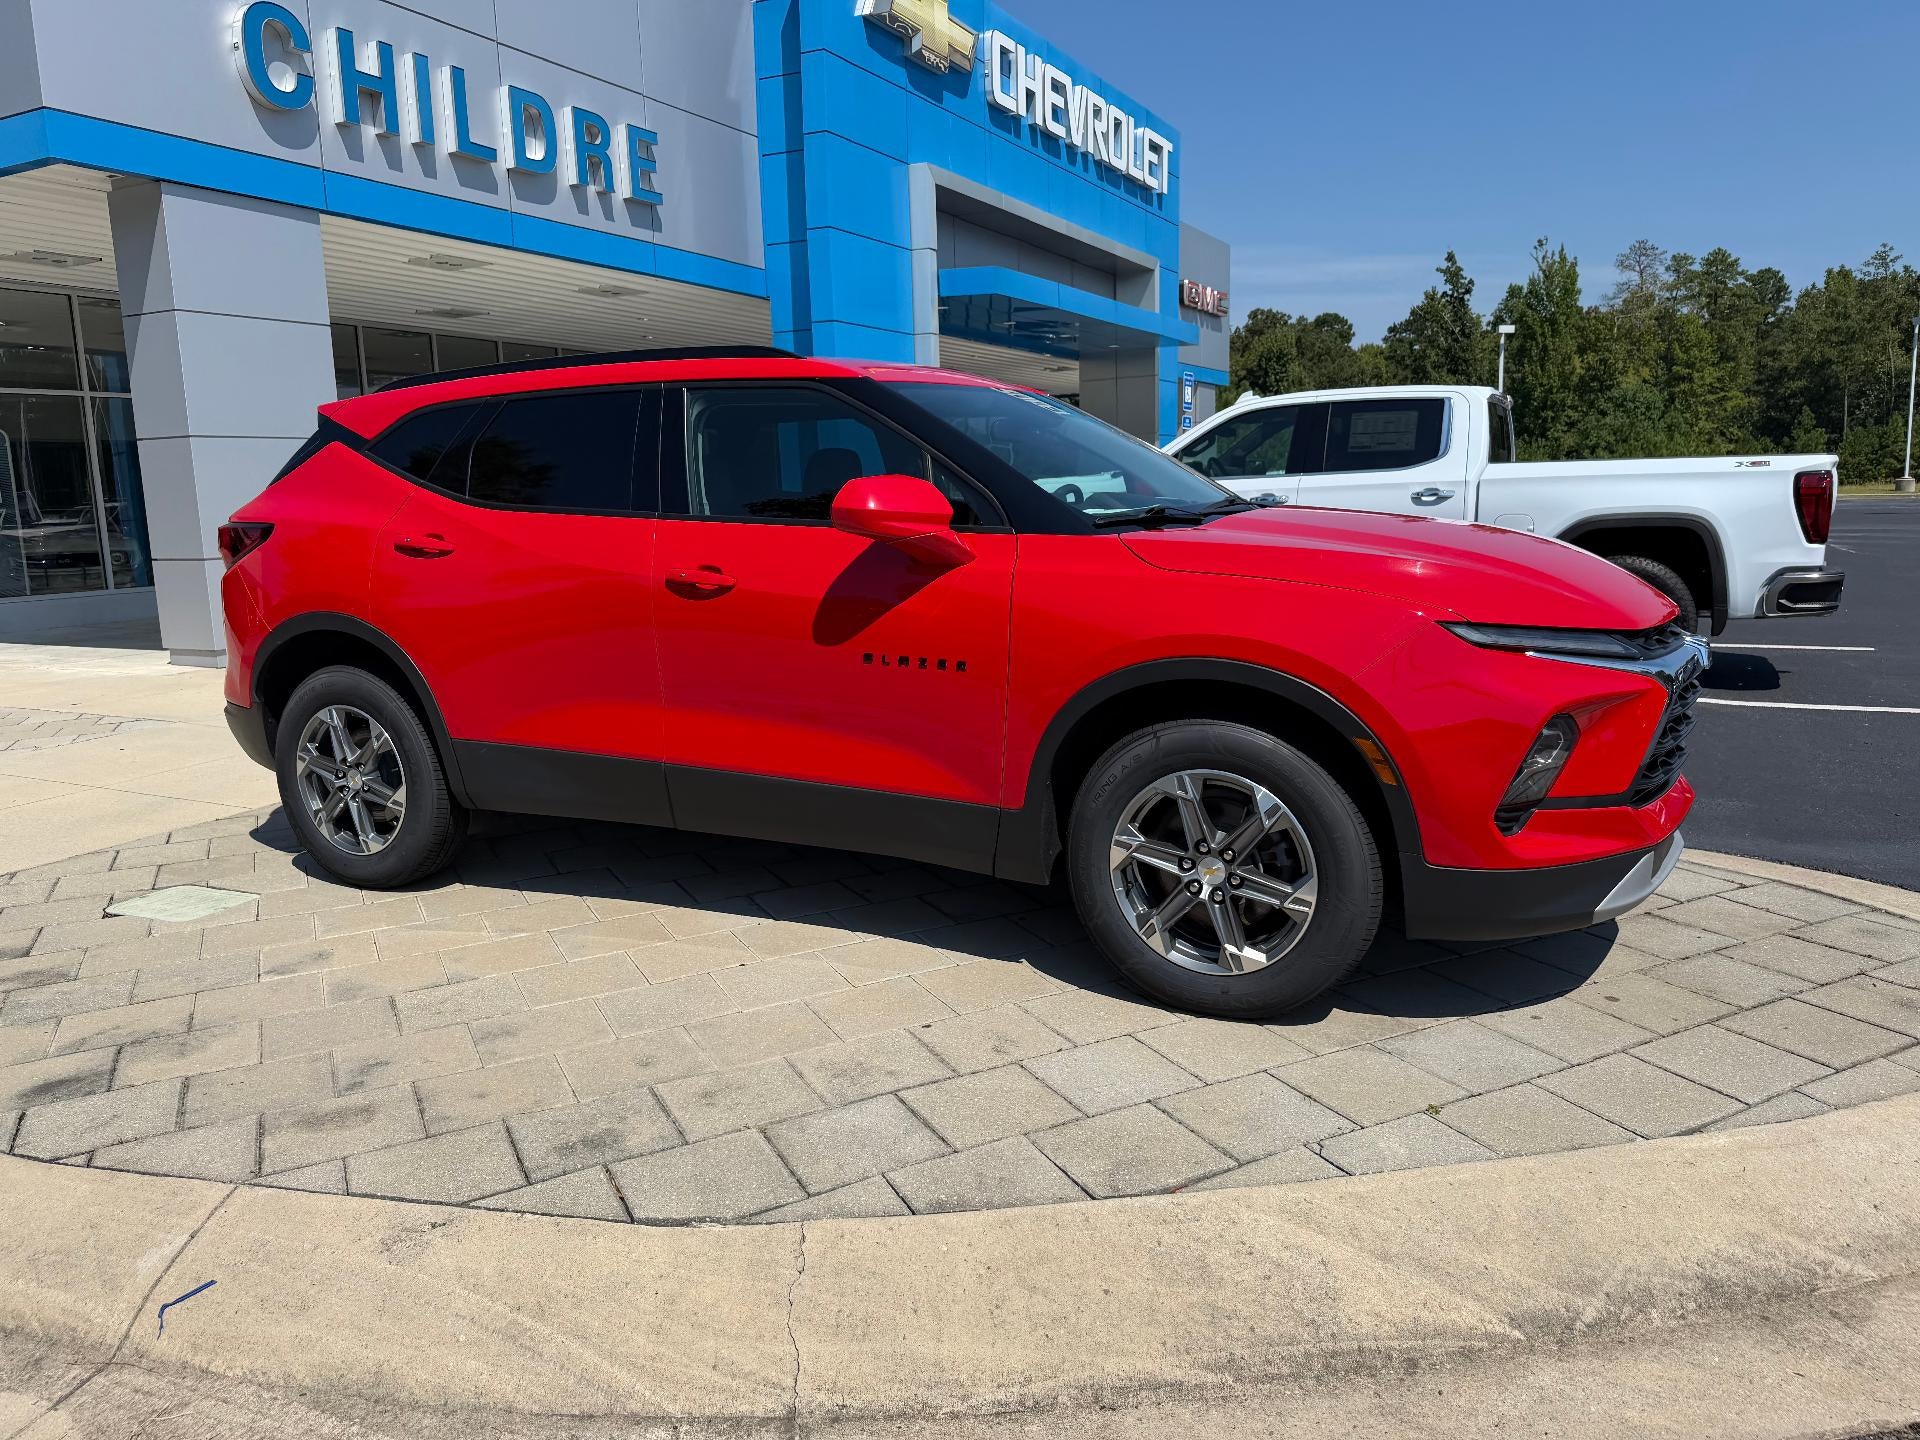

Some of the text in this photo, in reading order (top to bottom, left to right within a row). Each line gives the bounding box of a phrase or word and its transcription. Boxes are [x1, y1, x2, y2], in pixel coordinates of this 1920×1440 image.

[234, 0, 663, 205] CHILDRE
[985, 29, 1173, 195] CHEVROLET
[1180, 279, 1228, 317] GMC
